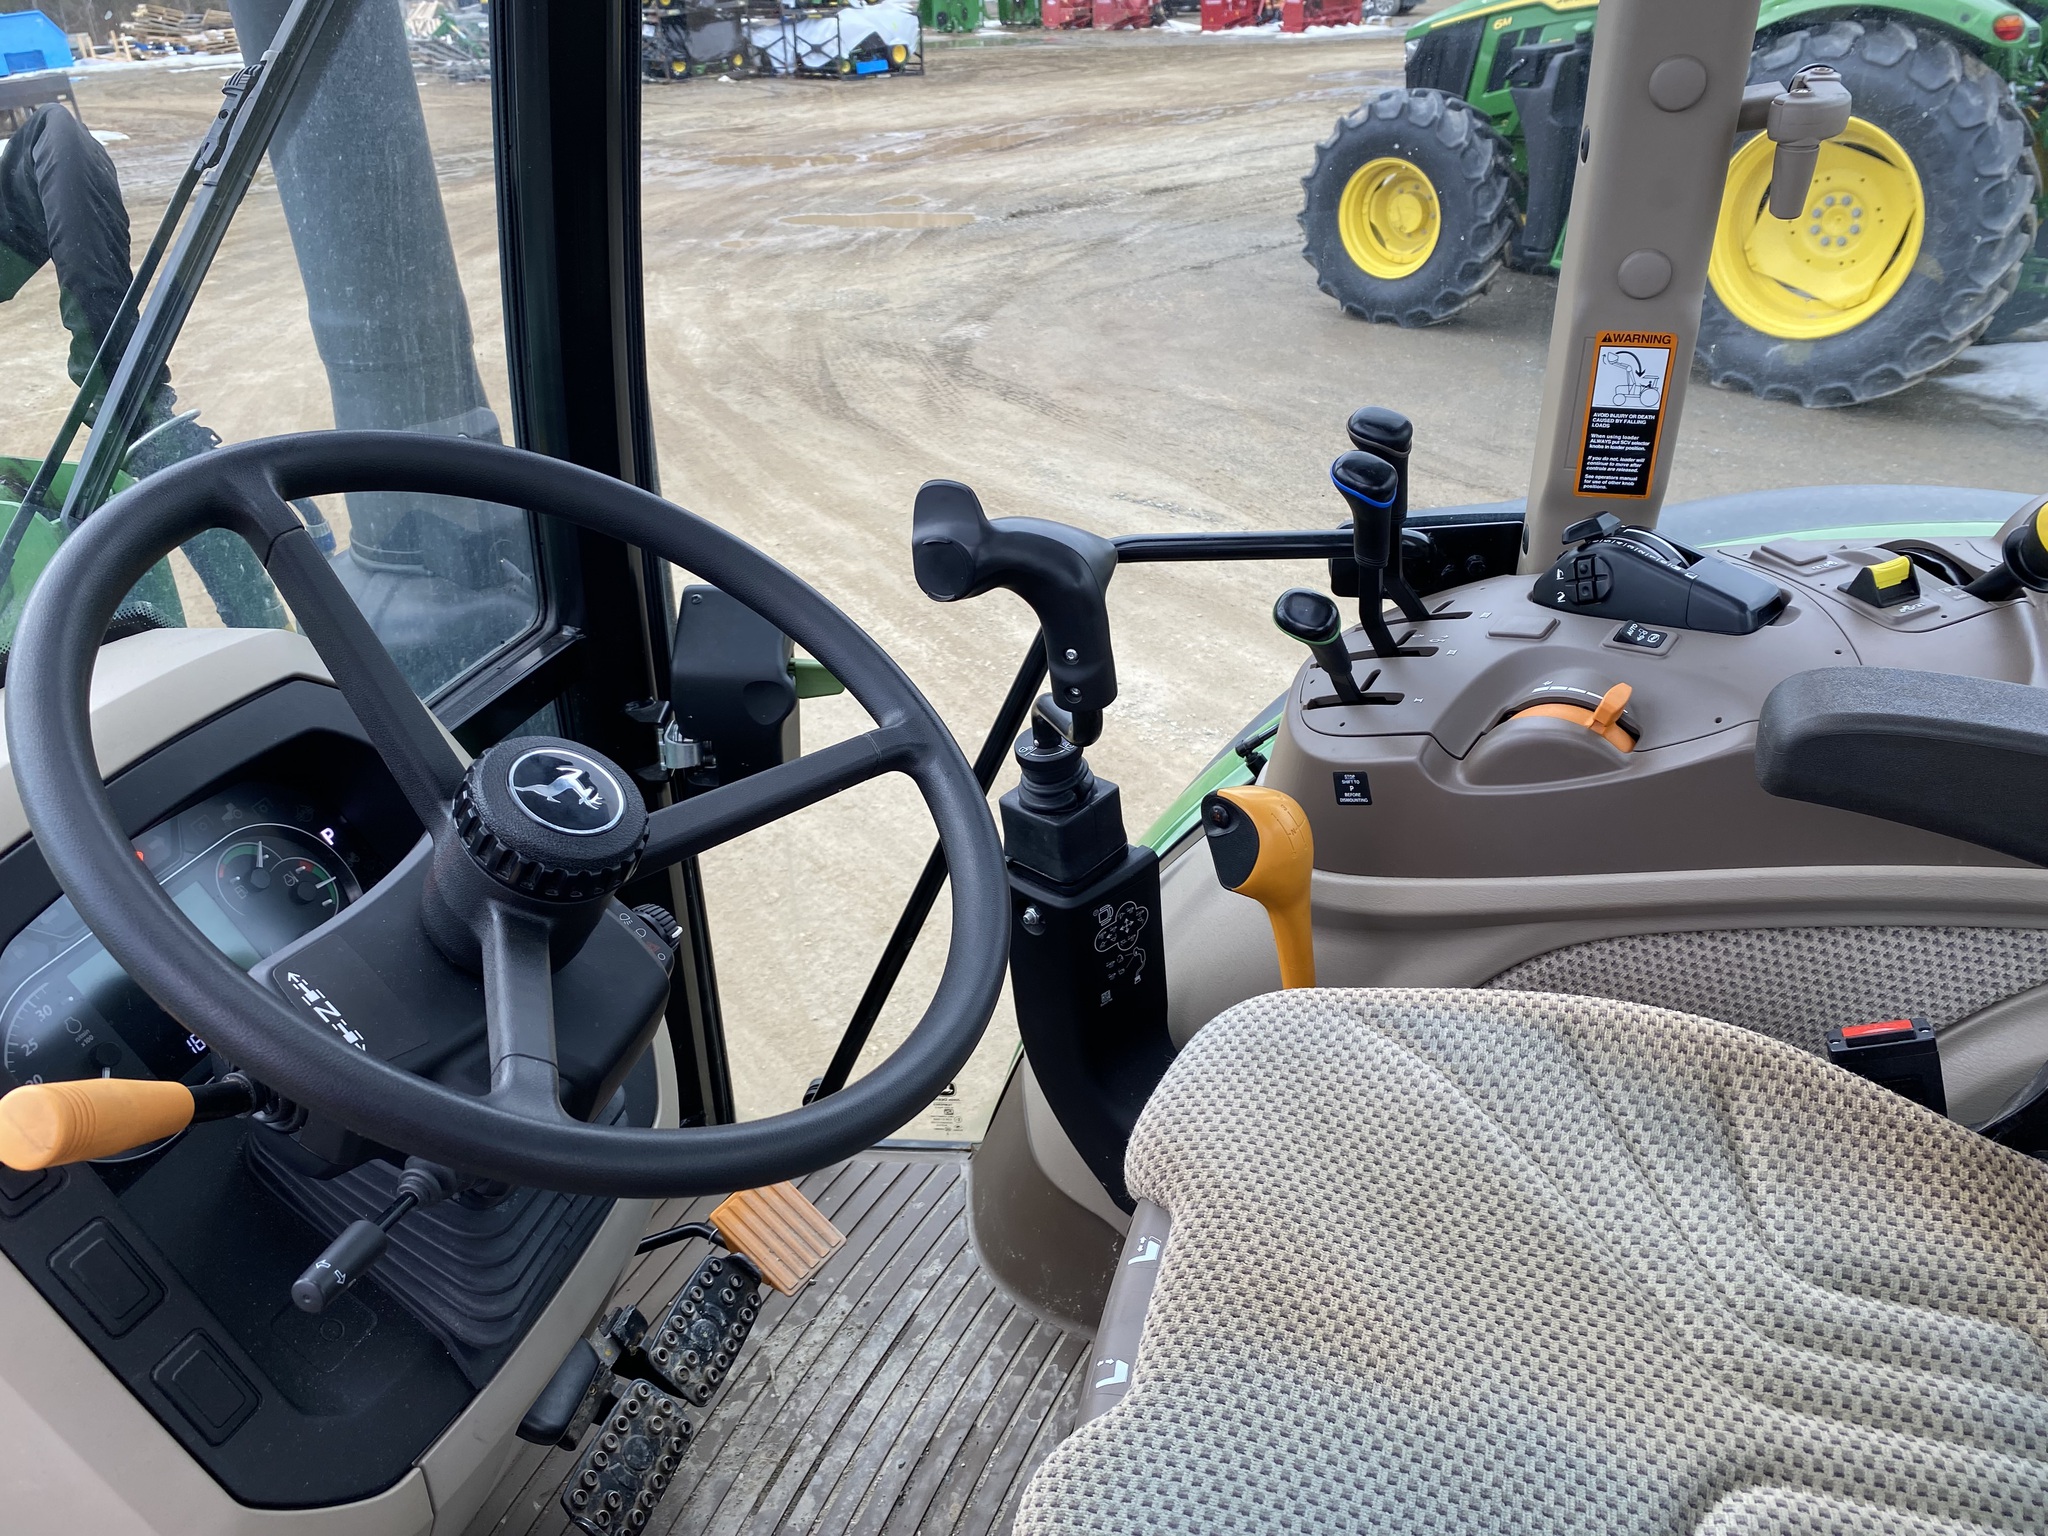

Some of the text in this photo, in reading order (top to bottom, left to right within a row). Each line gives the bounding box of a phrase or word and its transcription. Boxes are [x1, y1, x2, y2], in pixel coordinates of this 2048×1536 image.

[1493, 16, 1513, 30] 6M
[1613, 333, 1671, 344] WARNING
[1557, 591, 1566, 602] 2
[1627, 623, 1638, 636] AUTO
[320, 827, 334, 845] P
[35, 1004, 52, 1022] 30
[313, 1000, 341, 1023] N
[20, 1038, 38, 1057] 25
